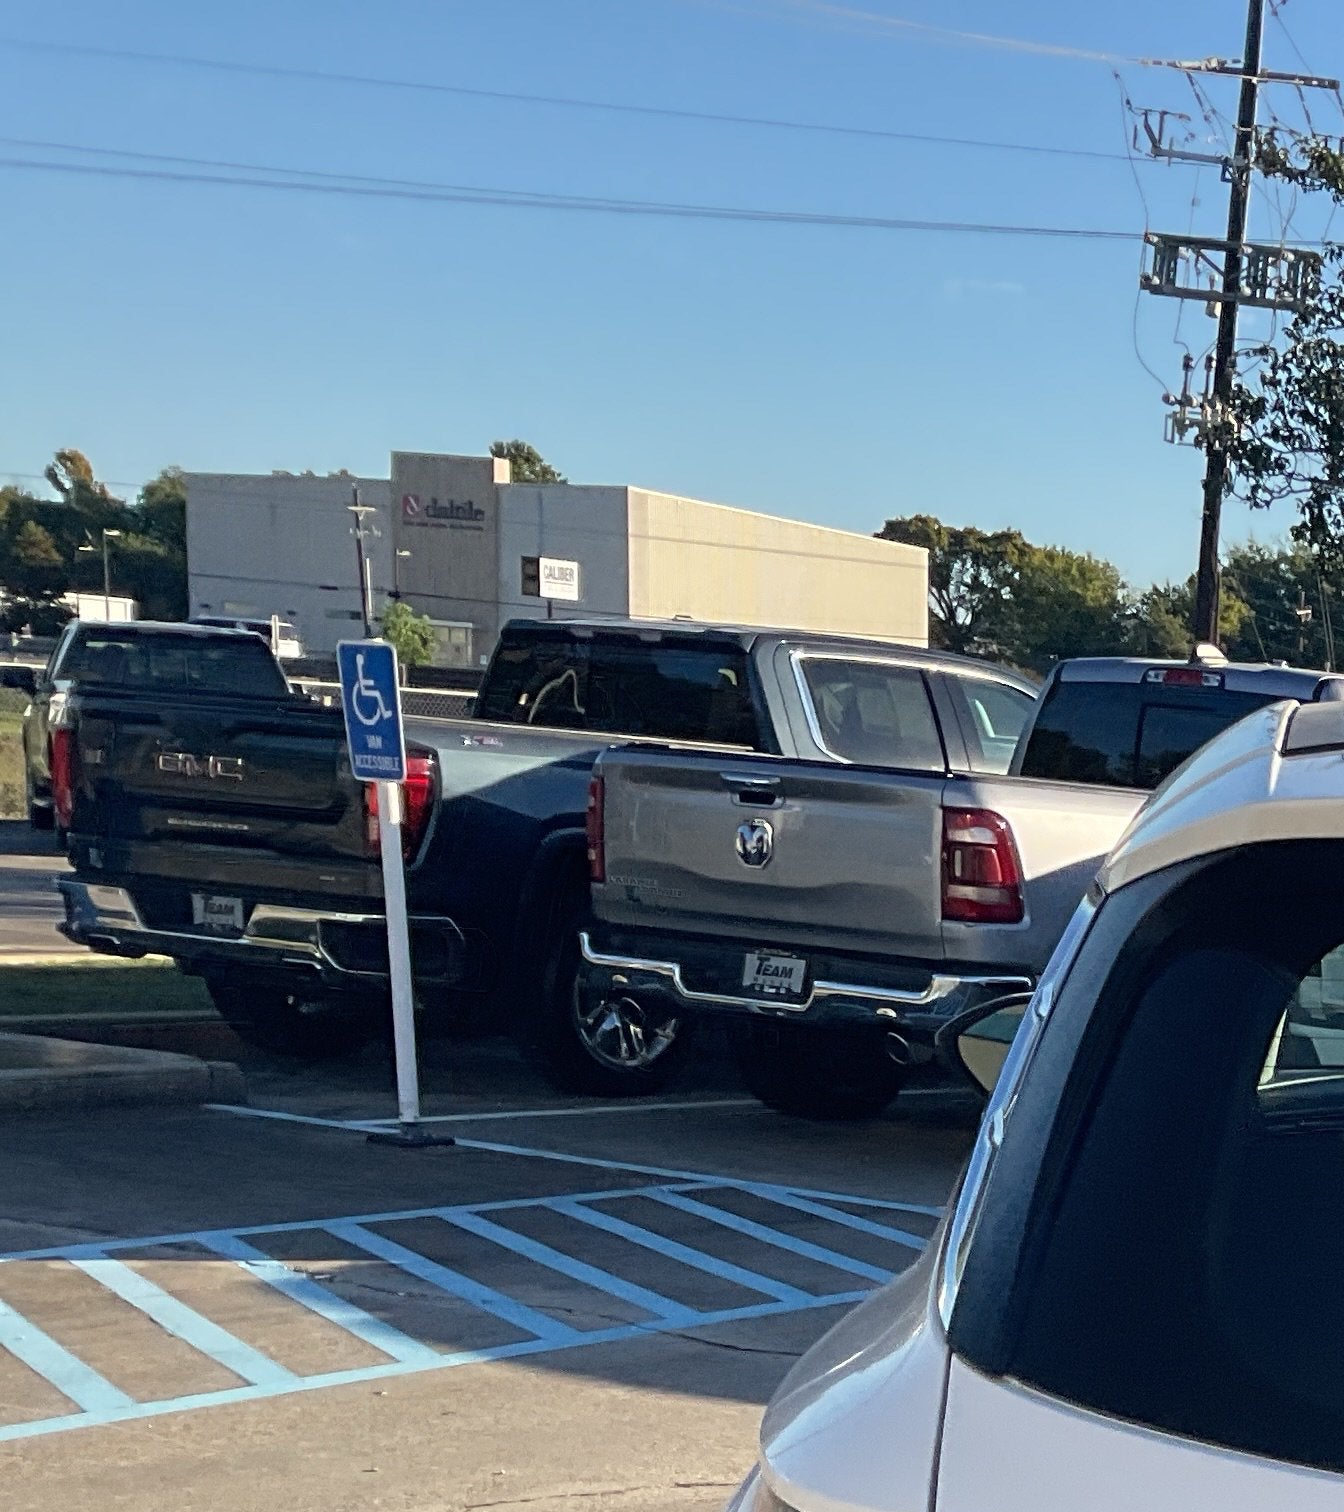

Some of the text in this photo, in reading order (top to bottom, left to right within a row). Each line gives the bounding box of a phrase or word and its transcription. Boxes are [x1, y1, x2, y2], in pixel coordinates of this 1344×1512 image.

[543, 564, 575, 582] CALIBER
[365, 734, 383, 749] VAN
[156, 752, 243, 781] GMC
[354, 754, 400, 771] ACCESSIBLE
[755, 956, 794, 979] TEAM
